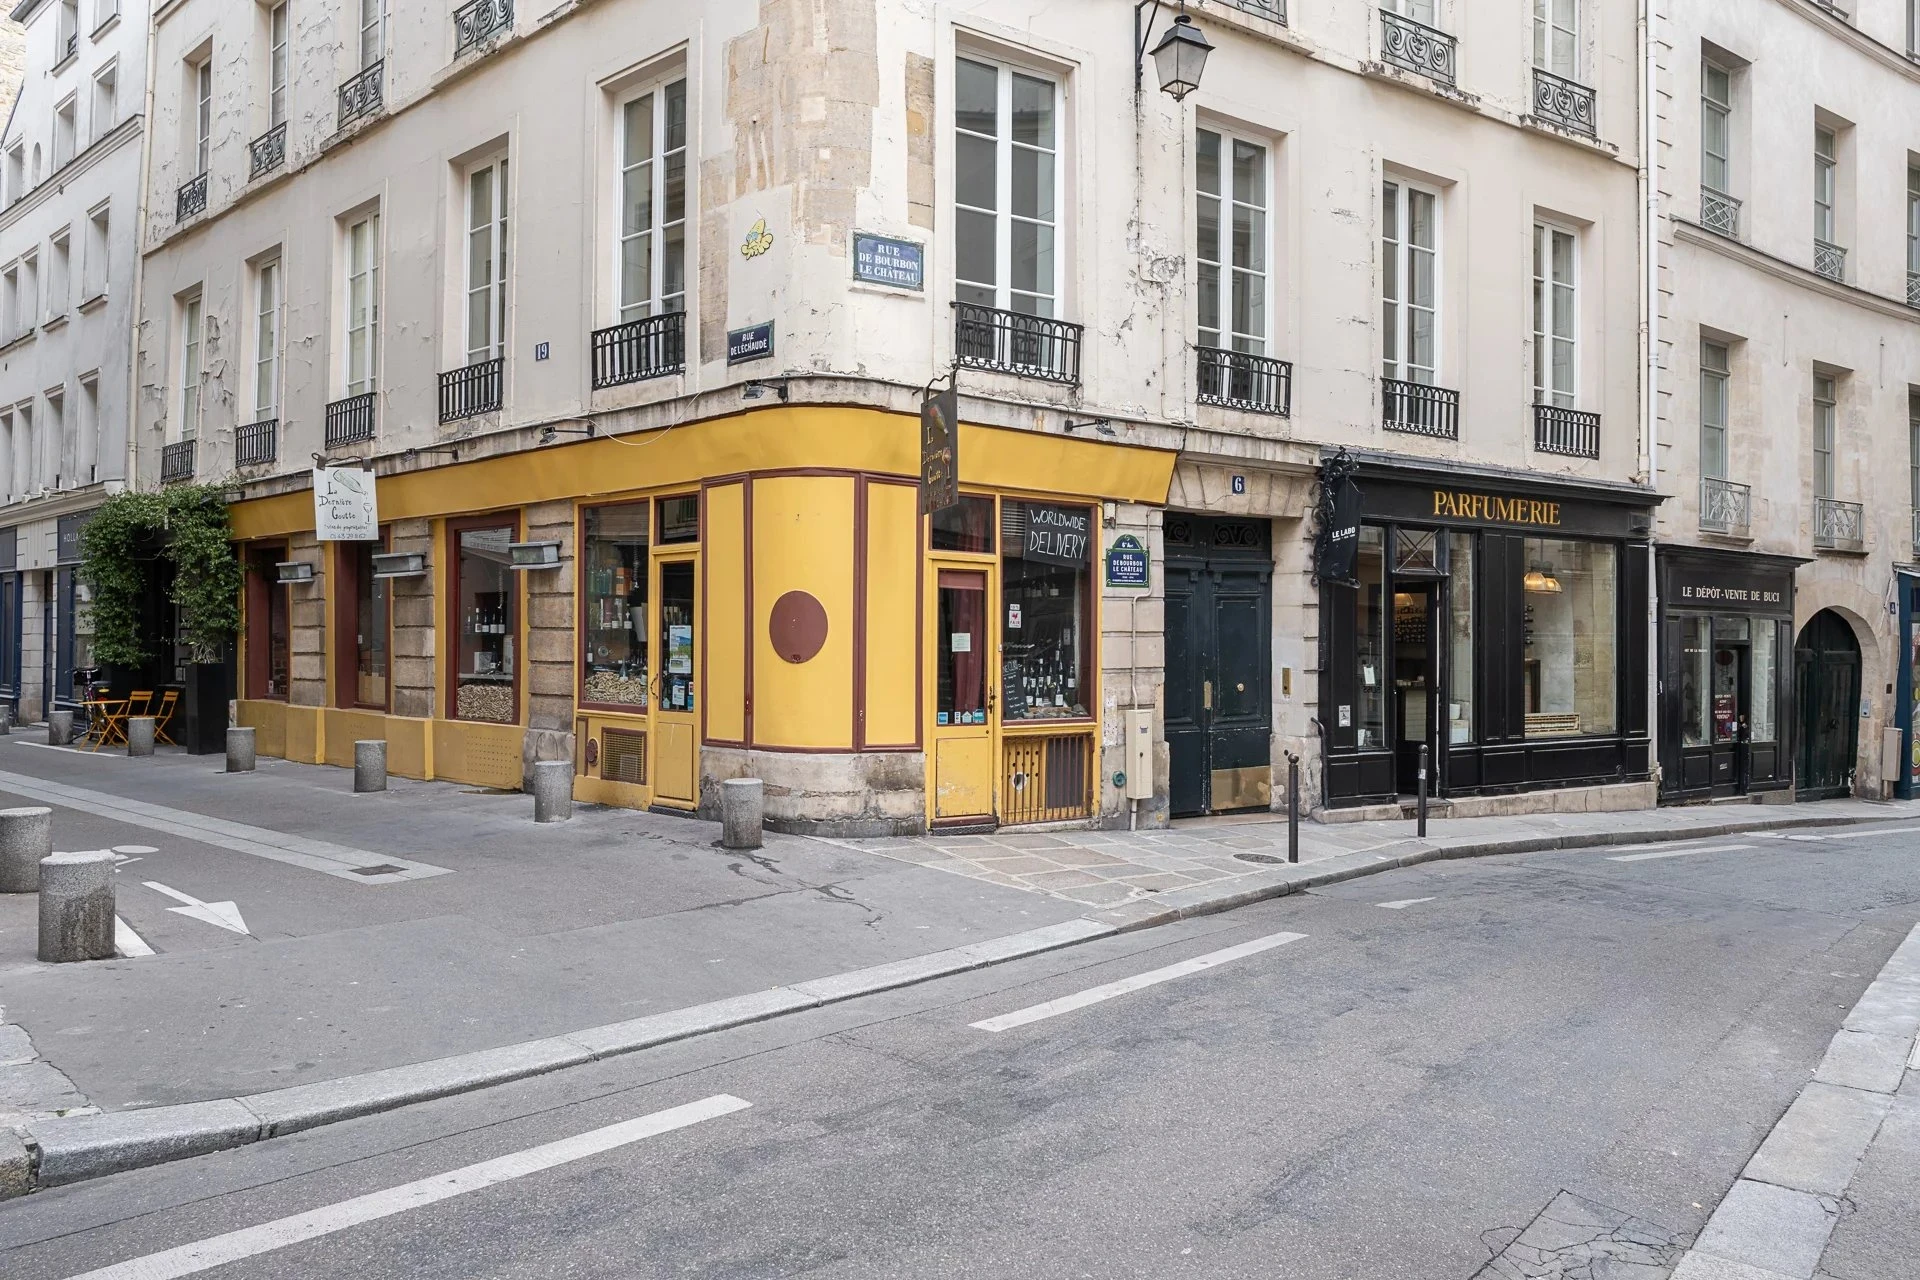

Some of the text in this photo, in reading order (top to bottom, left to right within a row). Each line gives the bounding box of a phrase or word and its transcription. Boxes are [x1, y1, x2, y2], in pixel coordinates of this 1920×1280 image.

[877, 243, 900, 257] RUE
[859, 252, 919, 271] DE BOURBON
[859, 263, 918, 282] LE CHÂTEAU
[742, 331, 755, 342] RUE
[537, 343, 548, 360] 19
[1234, 477, 1243, 492] 6
[1433, 491, 1561, 525] PARFUMERIE
[1030, 509, 1086, 531] WORLDWIDE
[1332, 530, 1340, 539] LE
[1340, 526, 1356, 537] LABO
[1029, 530, 1087, 559] DELIVERY
[1682, 586, 1693, 598] LE
[1750, 590, 1760, 601] DE
[1763, 591, 1780, 603] BUCI
